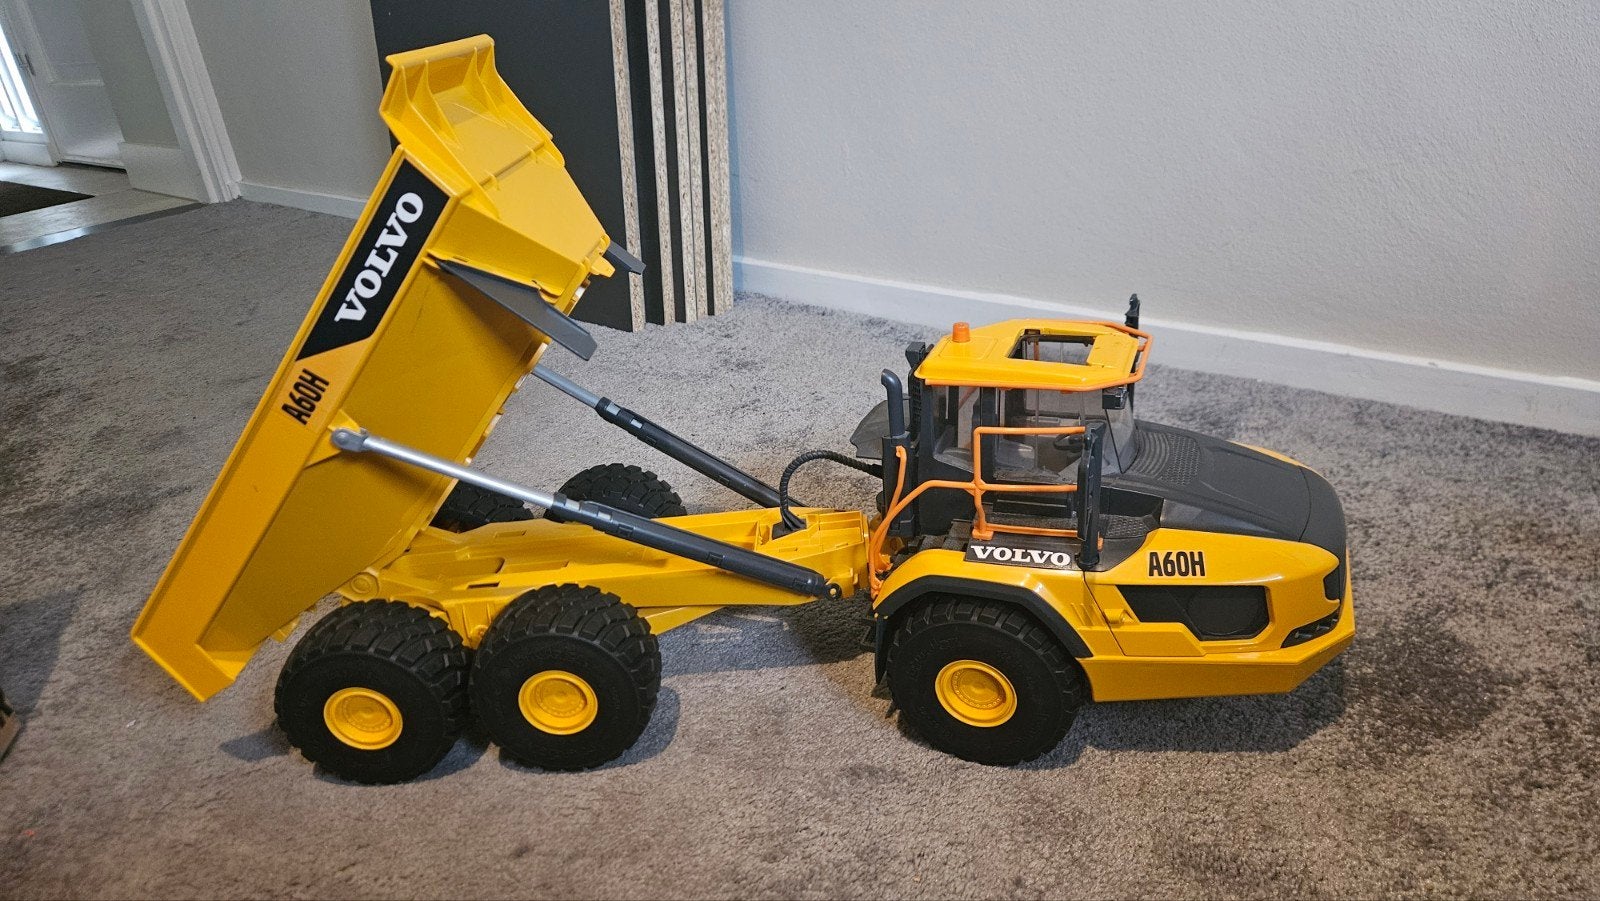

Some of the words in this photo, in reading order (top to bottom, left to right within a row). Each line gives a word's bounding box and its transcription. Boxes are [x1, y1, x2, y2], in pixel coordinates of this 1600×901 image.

[334, 192, 424, 322] VOLVO
[281, 369, 330, 425] A60H
[970, 545, 1071, 566] VOLVO
[1148, 551, 1206, 577] A60H
